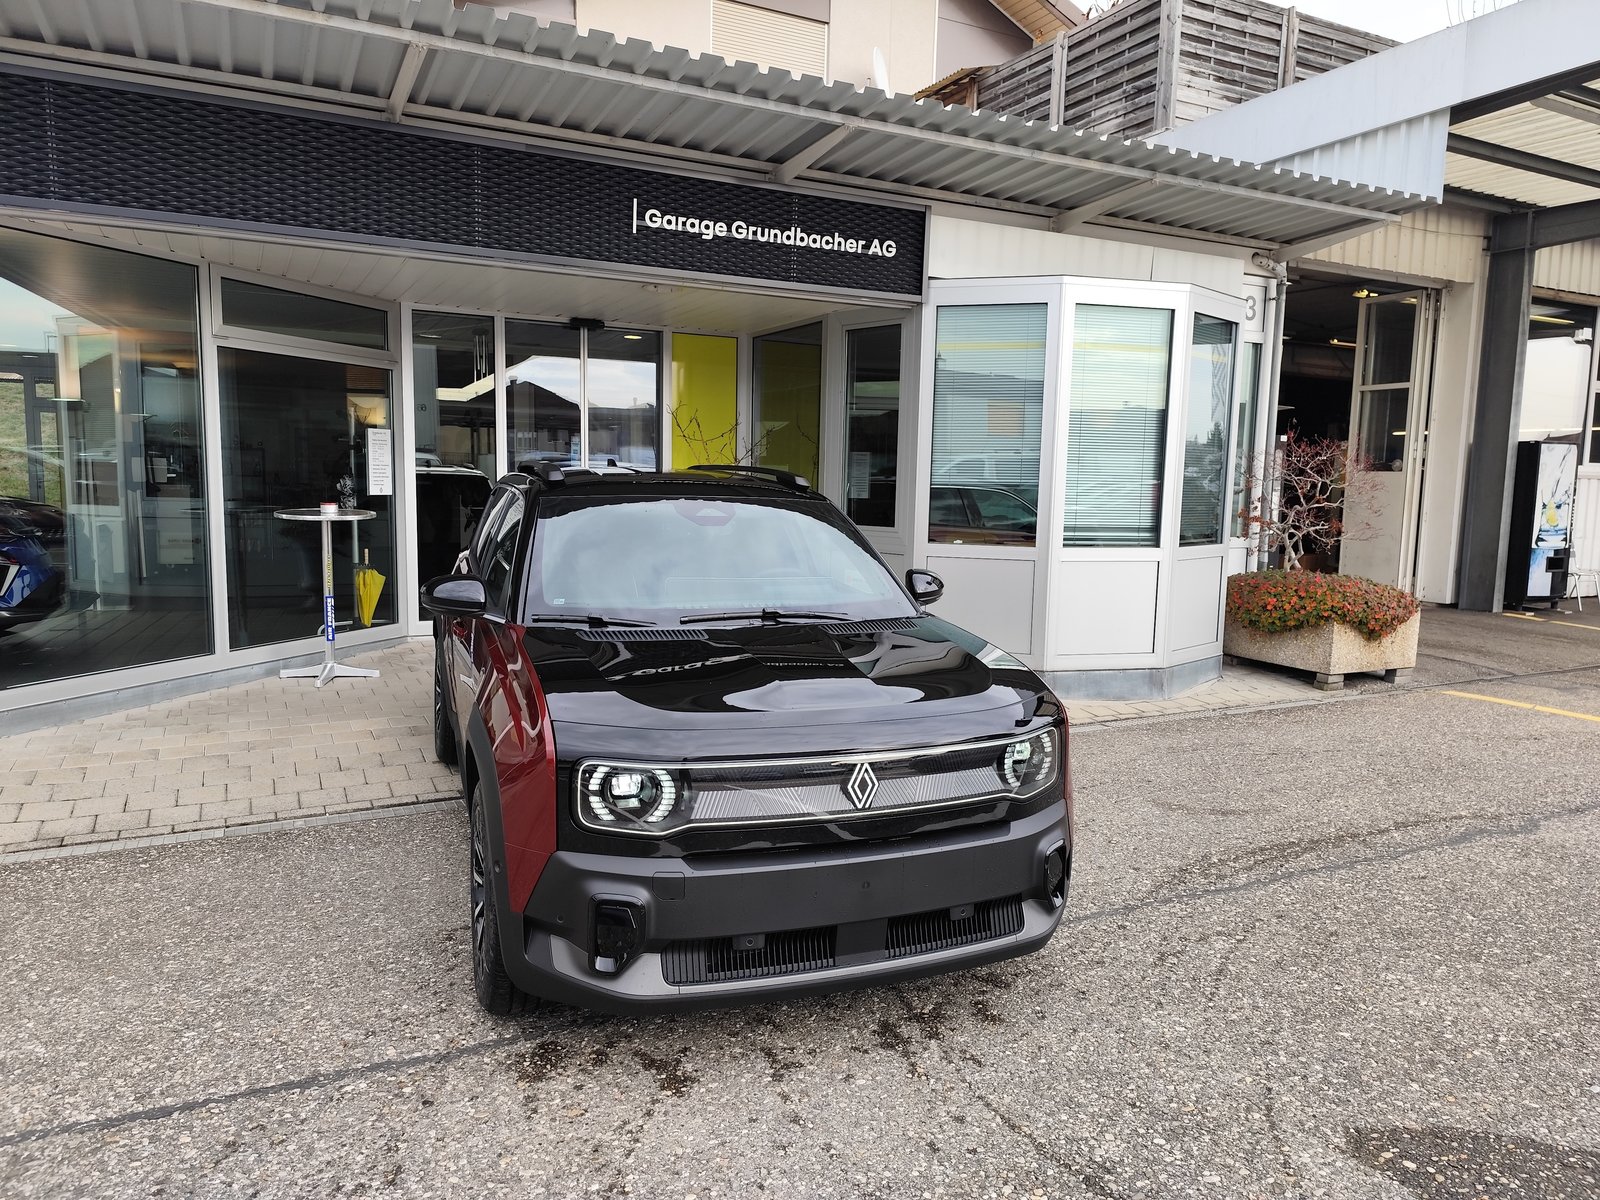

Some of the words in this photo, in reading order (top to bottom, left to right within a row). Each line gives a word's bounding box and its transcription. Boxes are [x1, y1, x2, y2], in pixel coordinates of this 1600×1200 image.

[645, 209, 727, 240] Garage
[731, 220, 866, 254] Grundbacher
[868, 238, 897, 258] AG
[1245, 295, 1257, 321] 3
